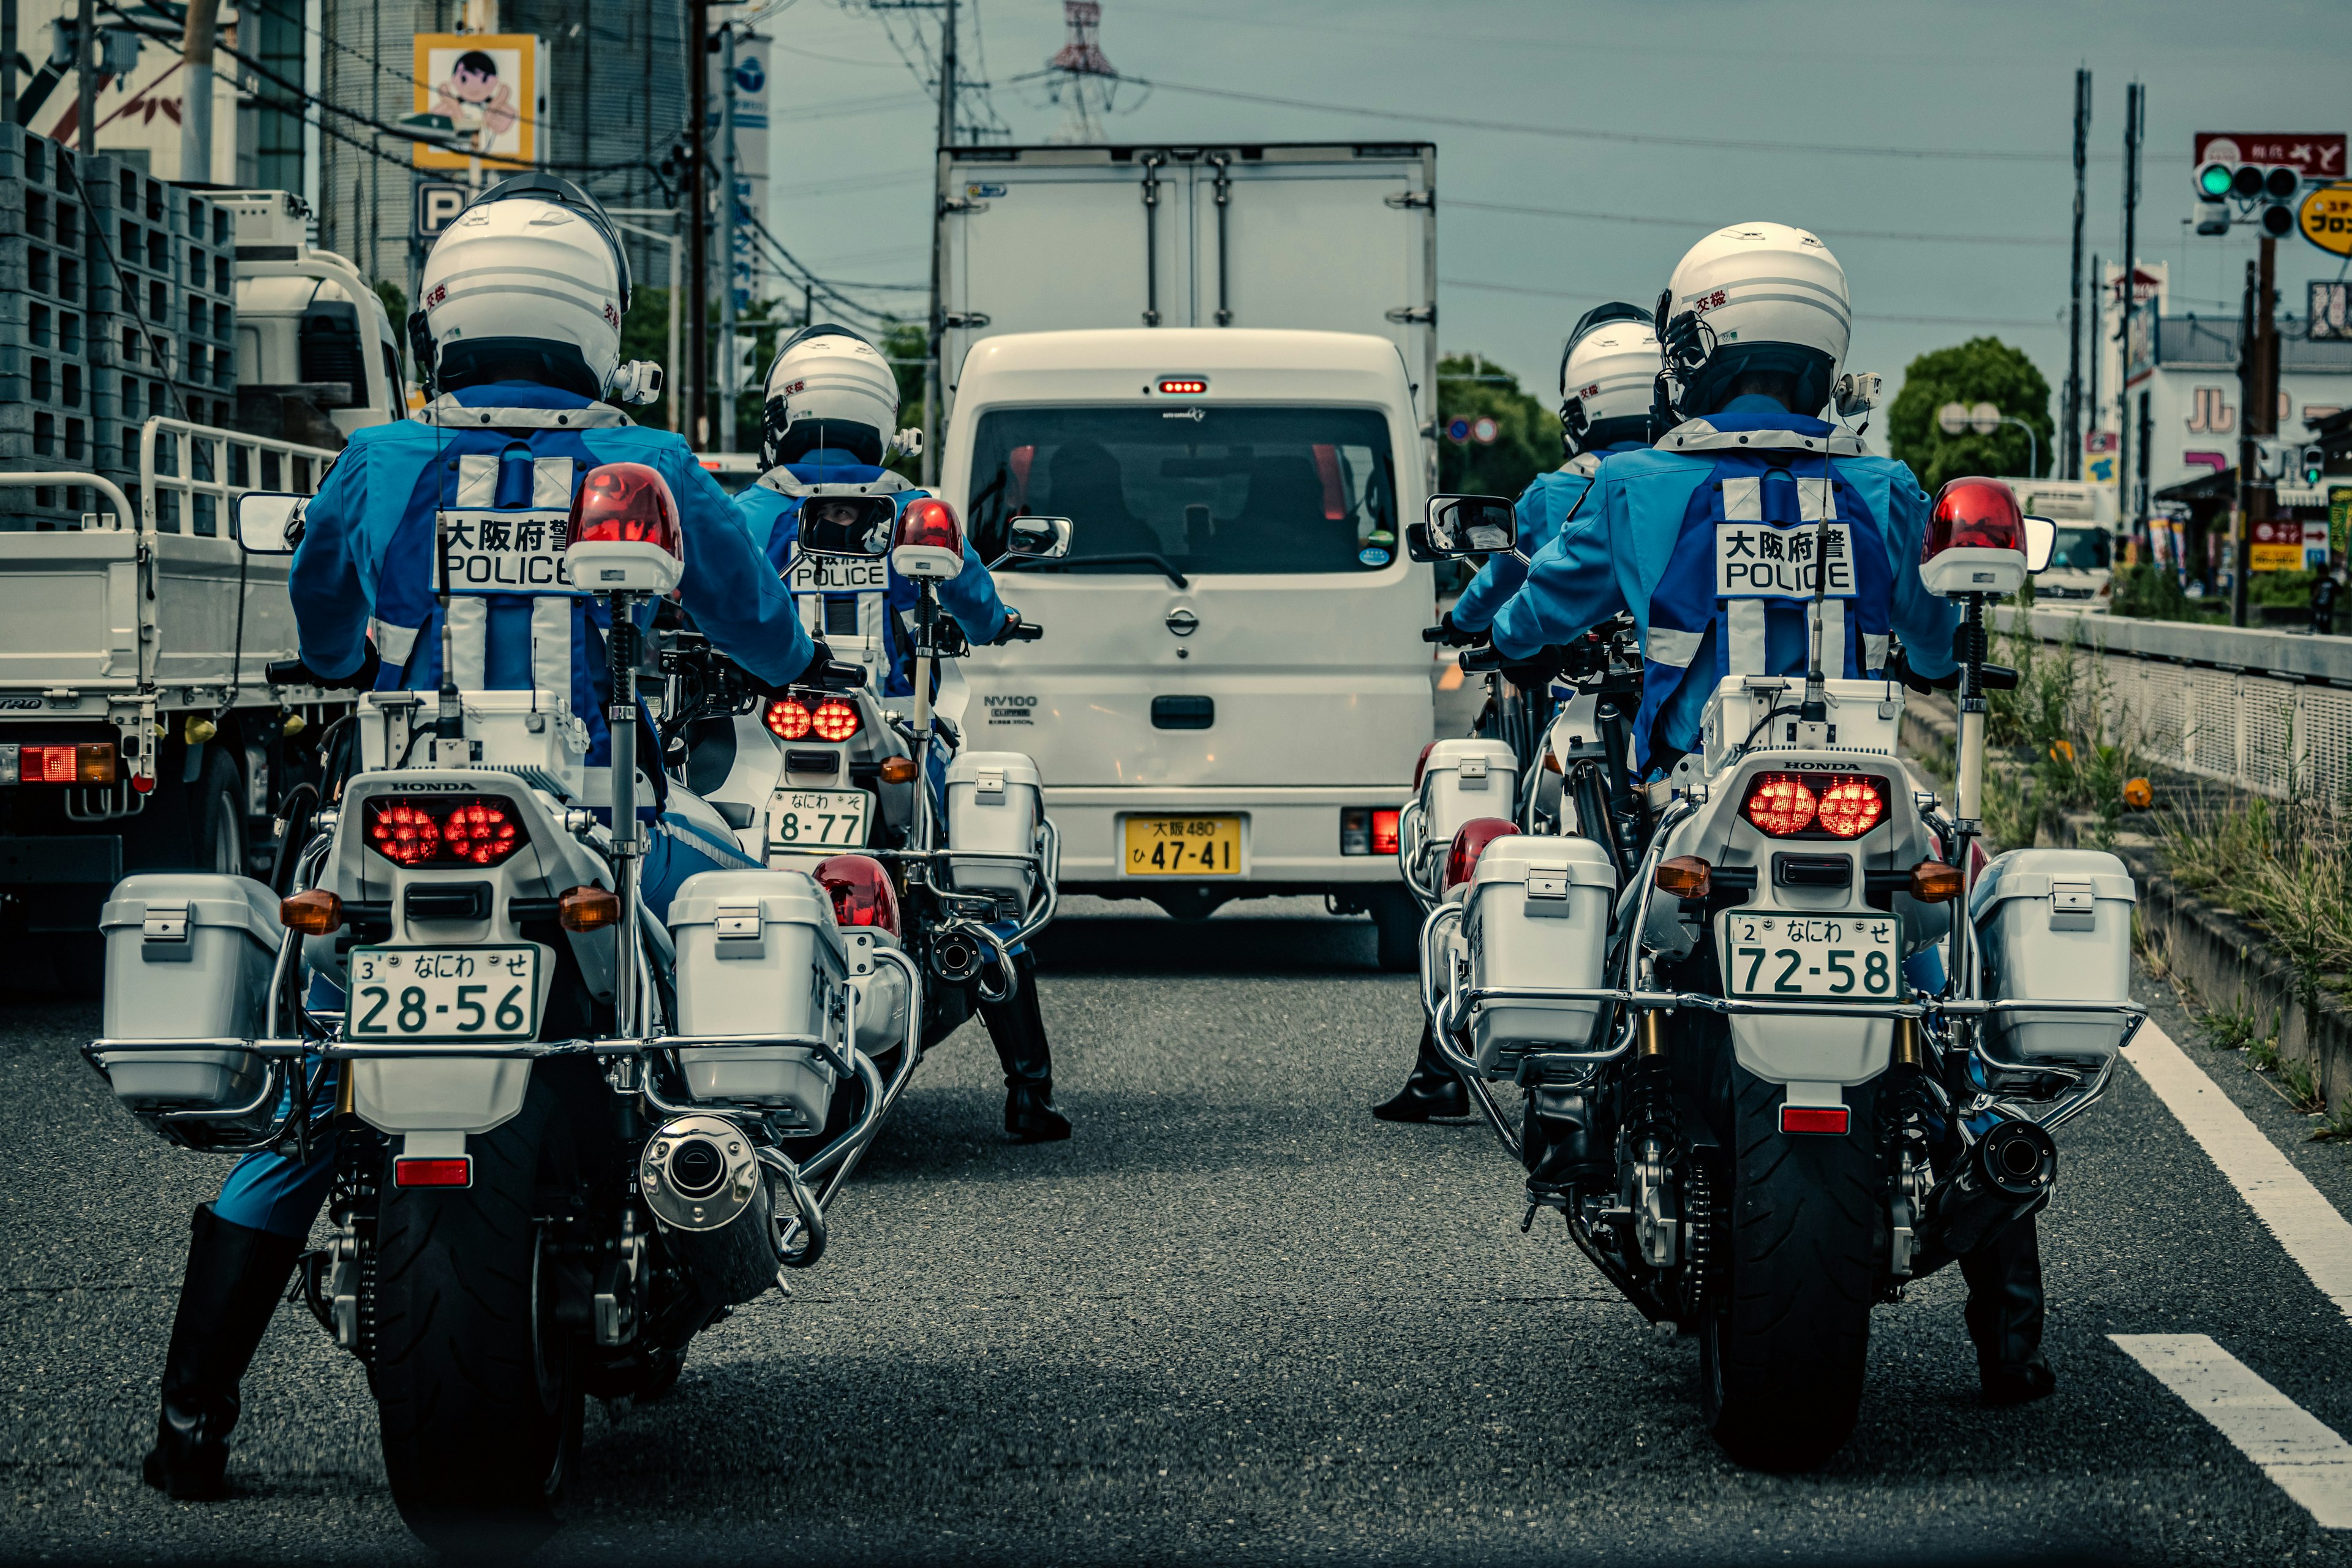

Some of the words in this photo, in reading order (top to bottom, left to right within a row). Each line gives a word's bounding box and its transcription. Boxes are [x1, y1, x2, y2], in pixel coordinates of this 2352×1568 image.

[428, 190, 463, 230] P
[426, 284, 446, 311] 交機
[1696, 290, 1726, 314] 交機
[785, 380, 805, 396] 交機
[1580, 384, 1599, 399] 交機
[1725, 529, 1845, 562] 大阪府警
[797, 566, 884, 586] POLICE
[984, 696, 1037, 706] NV100
[1784, 761, 1861, 771] HONDA
[791, 794, 827, 809] なにわ
[847, 796, 860, 810] そ
[1153, 821, 1185, 837] 大阪
[1186, 821, 1215, 836] 480
[1133, 848, 1146, 863] ひ
[1151, 841, 1229, 870] 47-41
[1744, 924, 1755, 941] 2
[1787, 920, 1841, 943] なにわ
[1871, 922, 1890, 943] せ
[361, 962, 374, 979] 3
[415, 954, 474, 978] なにわ
[507, 954, 527, 977] せ
[1738, 948, 1890, 994] 72-58
[358, 984, 524, 1033] 28-56
